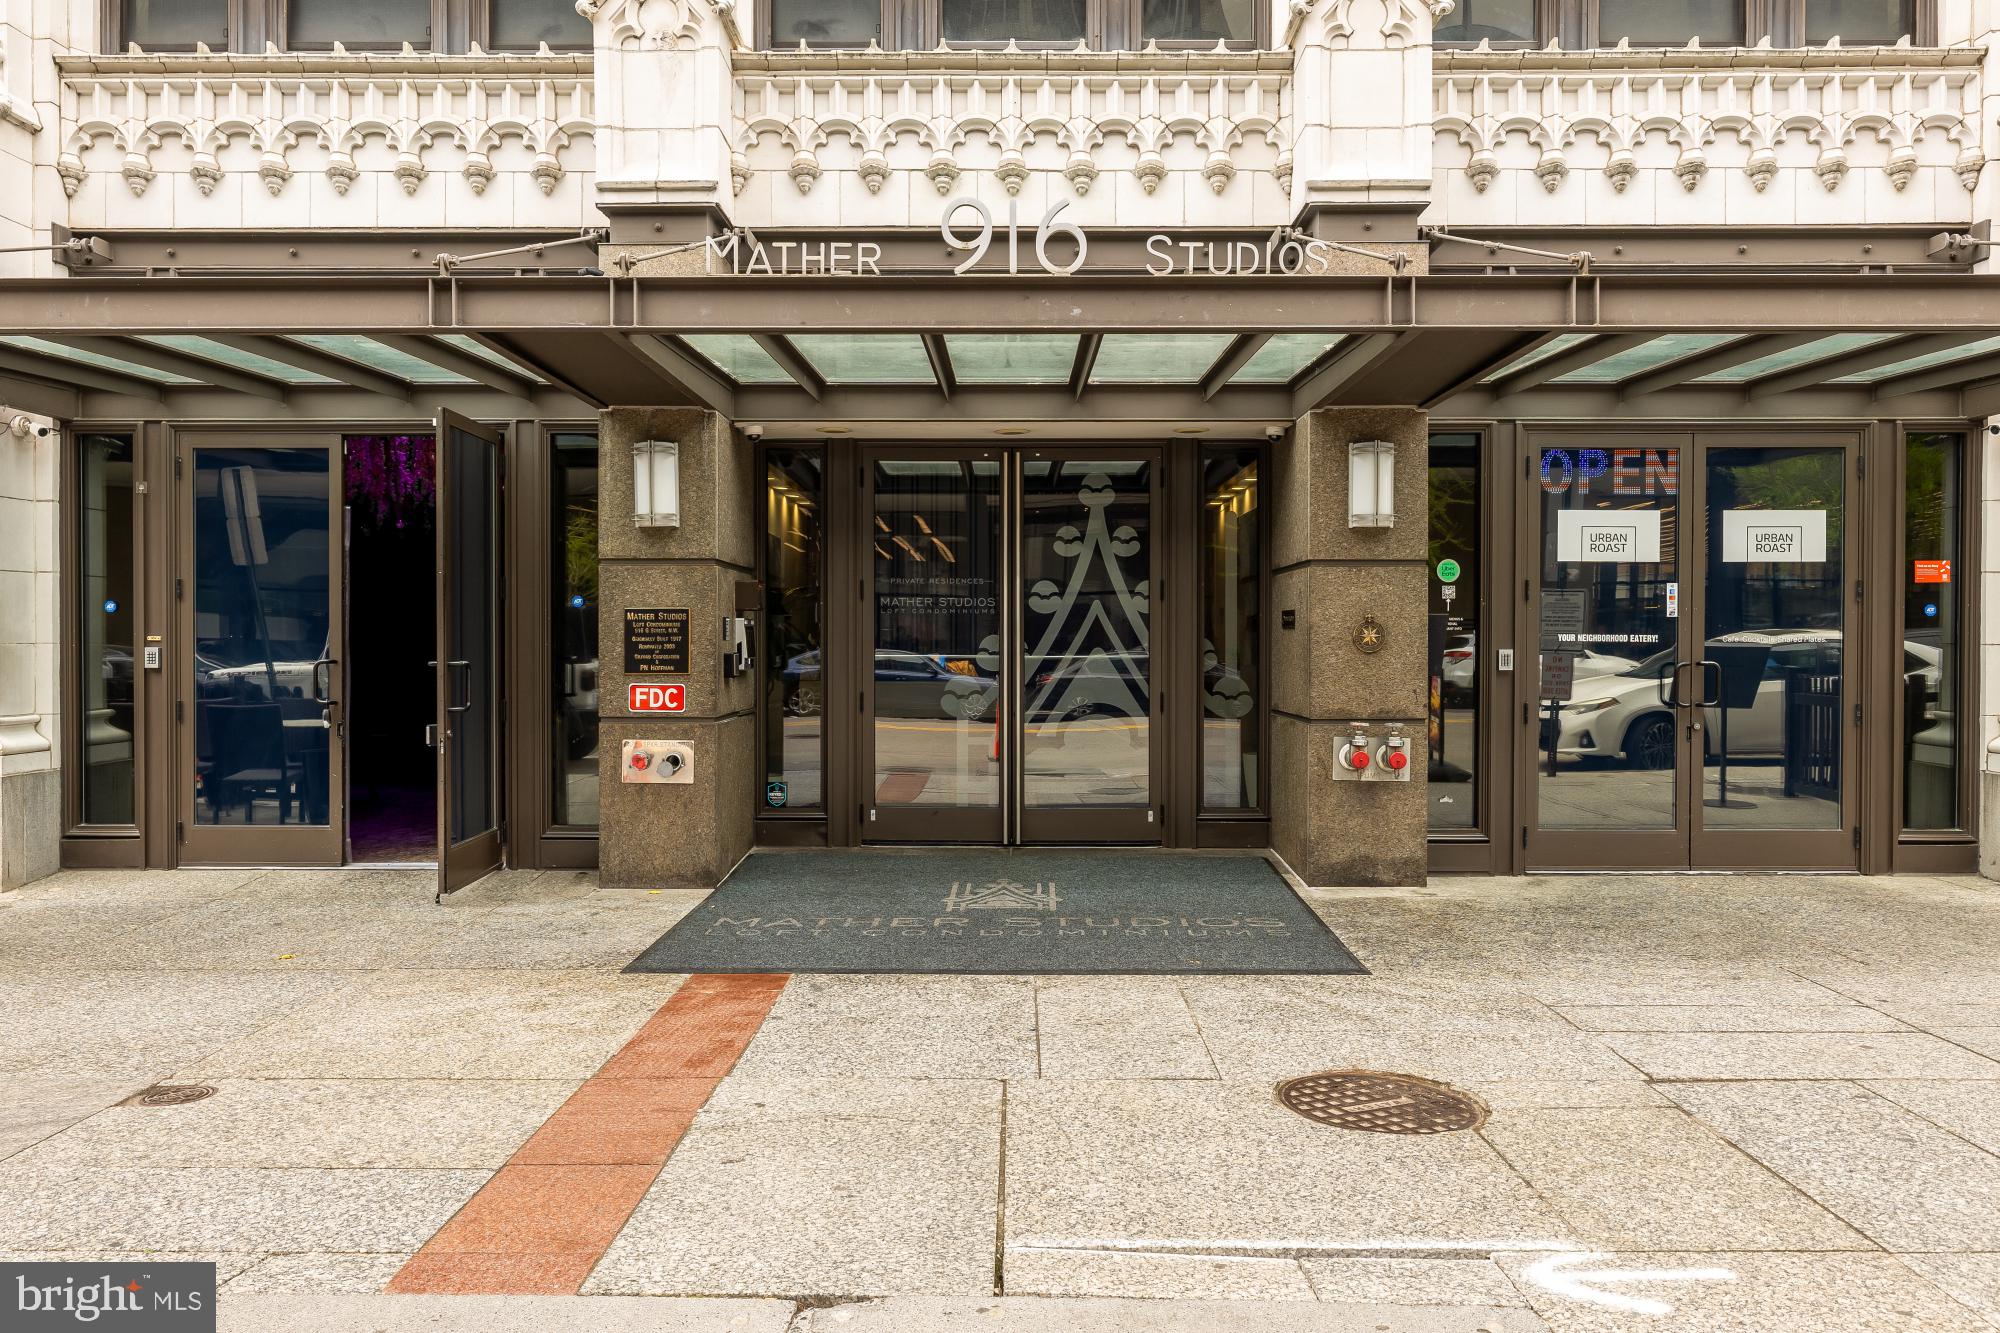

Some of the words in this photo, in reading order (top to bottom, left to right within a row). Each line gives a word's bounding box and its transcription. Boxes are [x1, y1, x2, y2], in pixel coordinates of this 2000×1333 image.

[705, 235, 882, 276] MATHER
[941, 197, 1088, 276] 916
[1145, 234, 1328, 276] STUDIOS
[1540, 448, 1677, 495] OPEN
[1590, 533, 1628, 542] URBAN
[1755, 533, 1793, 543] URBAN
[1590, 543, 1628, 553] ROAST
[1755, 543, 1793, 553] ROAST
[880, 597, 933, 607] MATHER
[939, 597, 996, 607] STUDIOS
[626, 612, 655, 620] MATHER
[658, 612, 687, 620] STUDIOS
[1557, 633, 1576, 642] YOUR
[1577, 634, 1628, 642] NEIGHBORHOOD
[1629, 634, 1659, 643] EATERY!
[635, 687, 679, 708] FDC
[711, 916, 971, 928] MATHER
[1003, 916, 1287, 928] STUDIOS
[704, 928, 834, 937] LOFT
[862, 928, 1292, 937] CONDOMINIUMS
